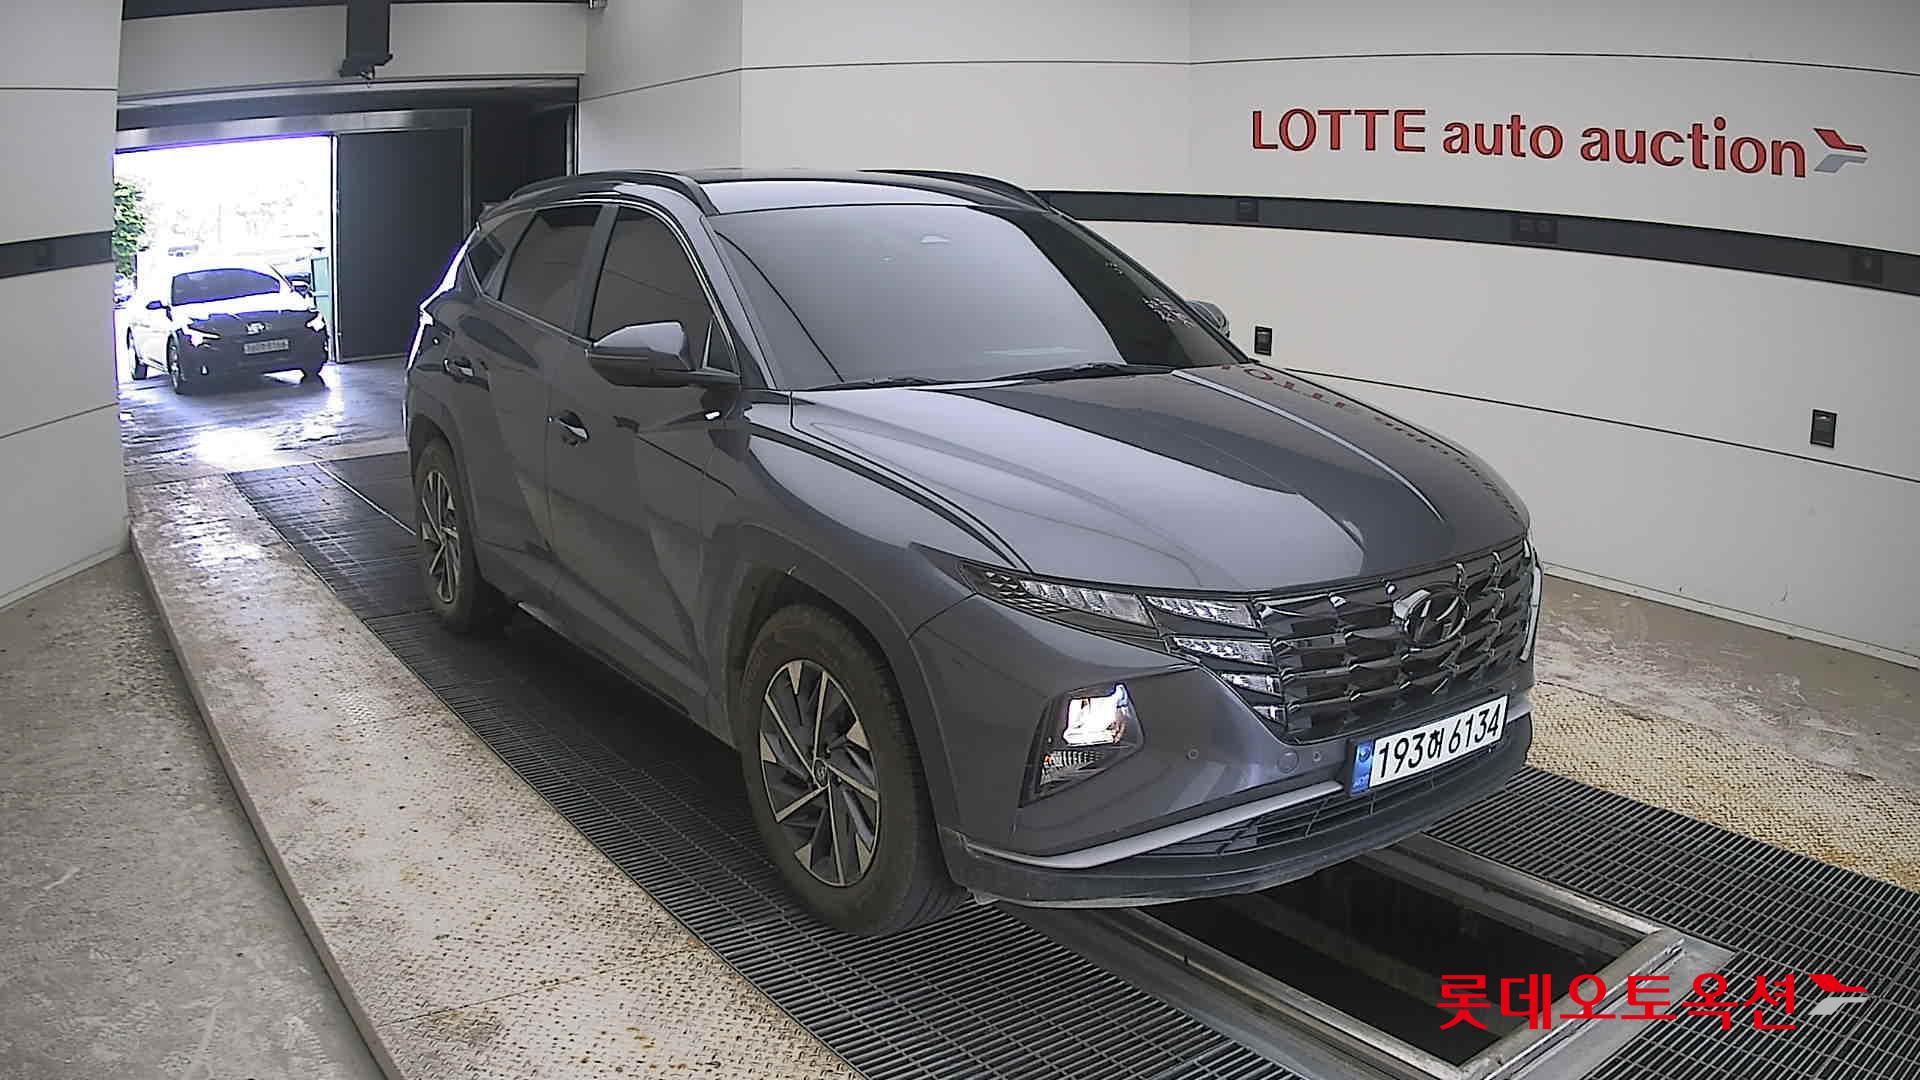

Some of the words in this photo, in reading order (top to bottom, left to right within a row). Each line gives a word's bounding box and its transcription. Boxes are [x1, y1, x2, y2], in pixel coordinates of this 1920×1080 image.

[1252, 109, 1426, 153] LOTTE
[1443, 115, 1564, 159] auto
[1581, 116, 1807, 179] auction
[1448, 703, 1501, 754] 6134
